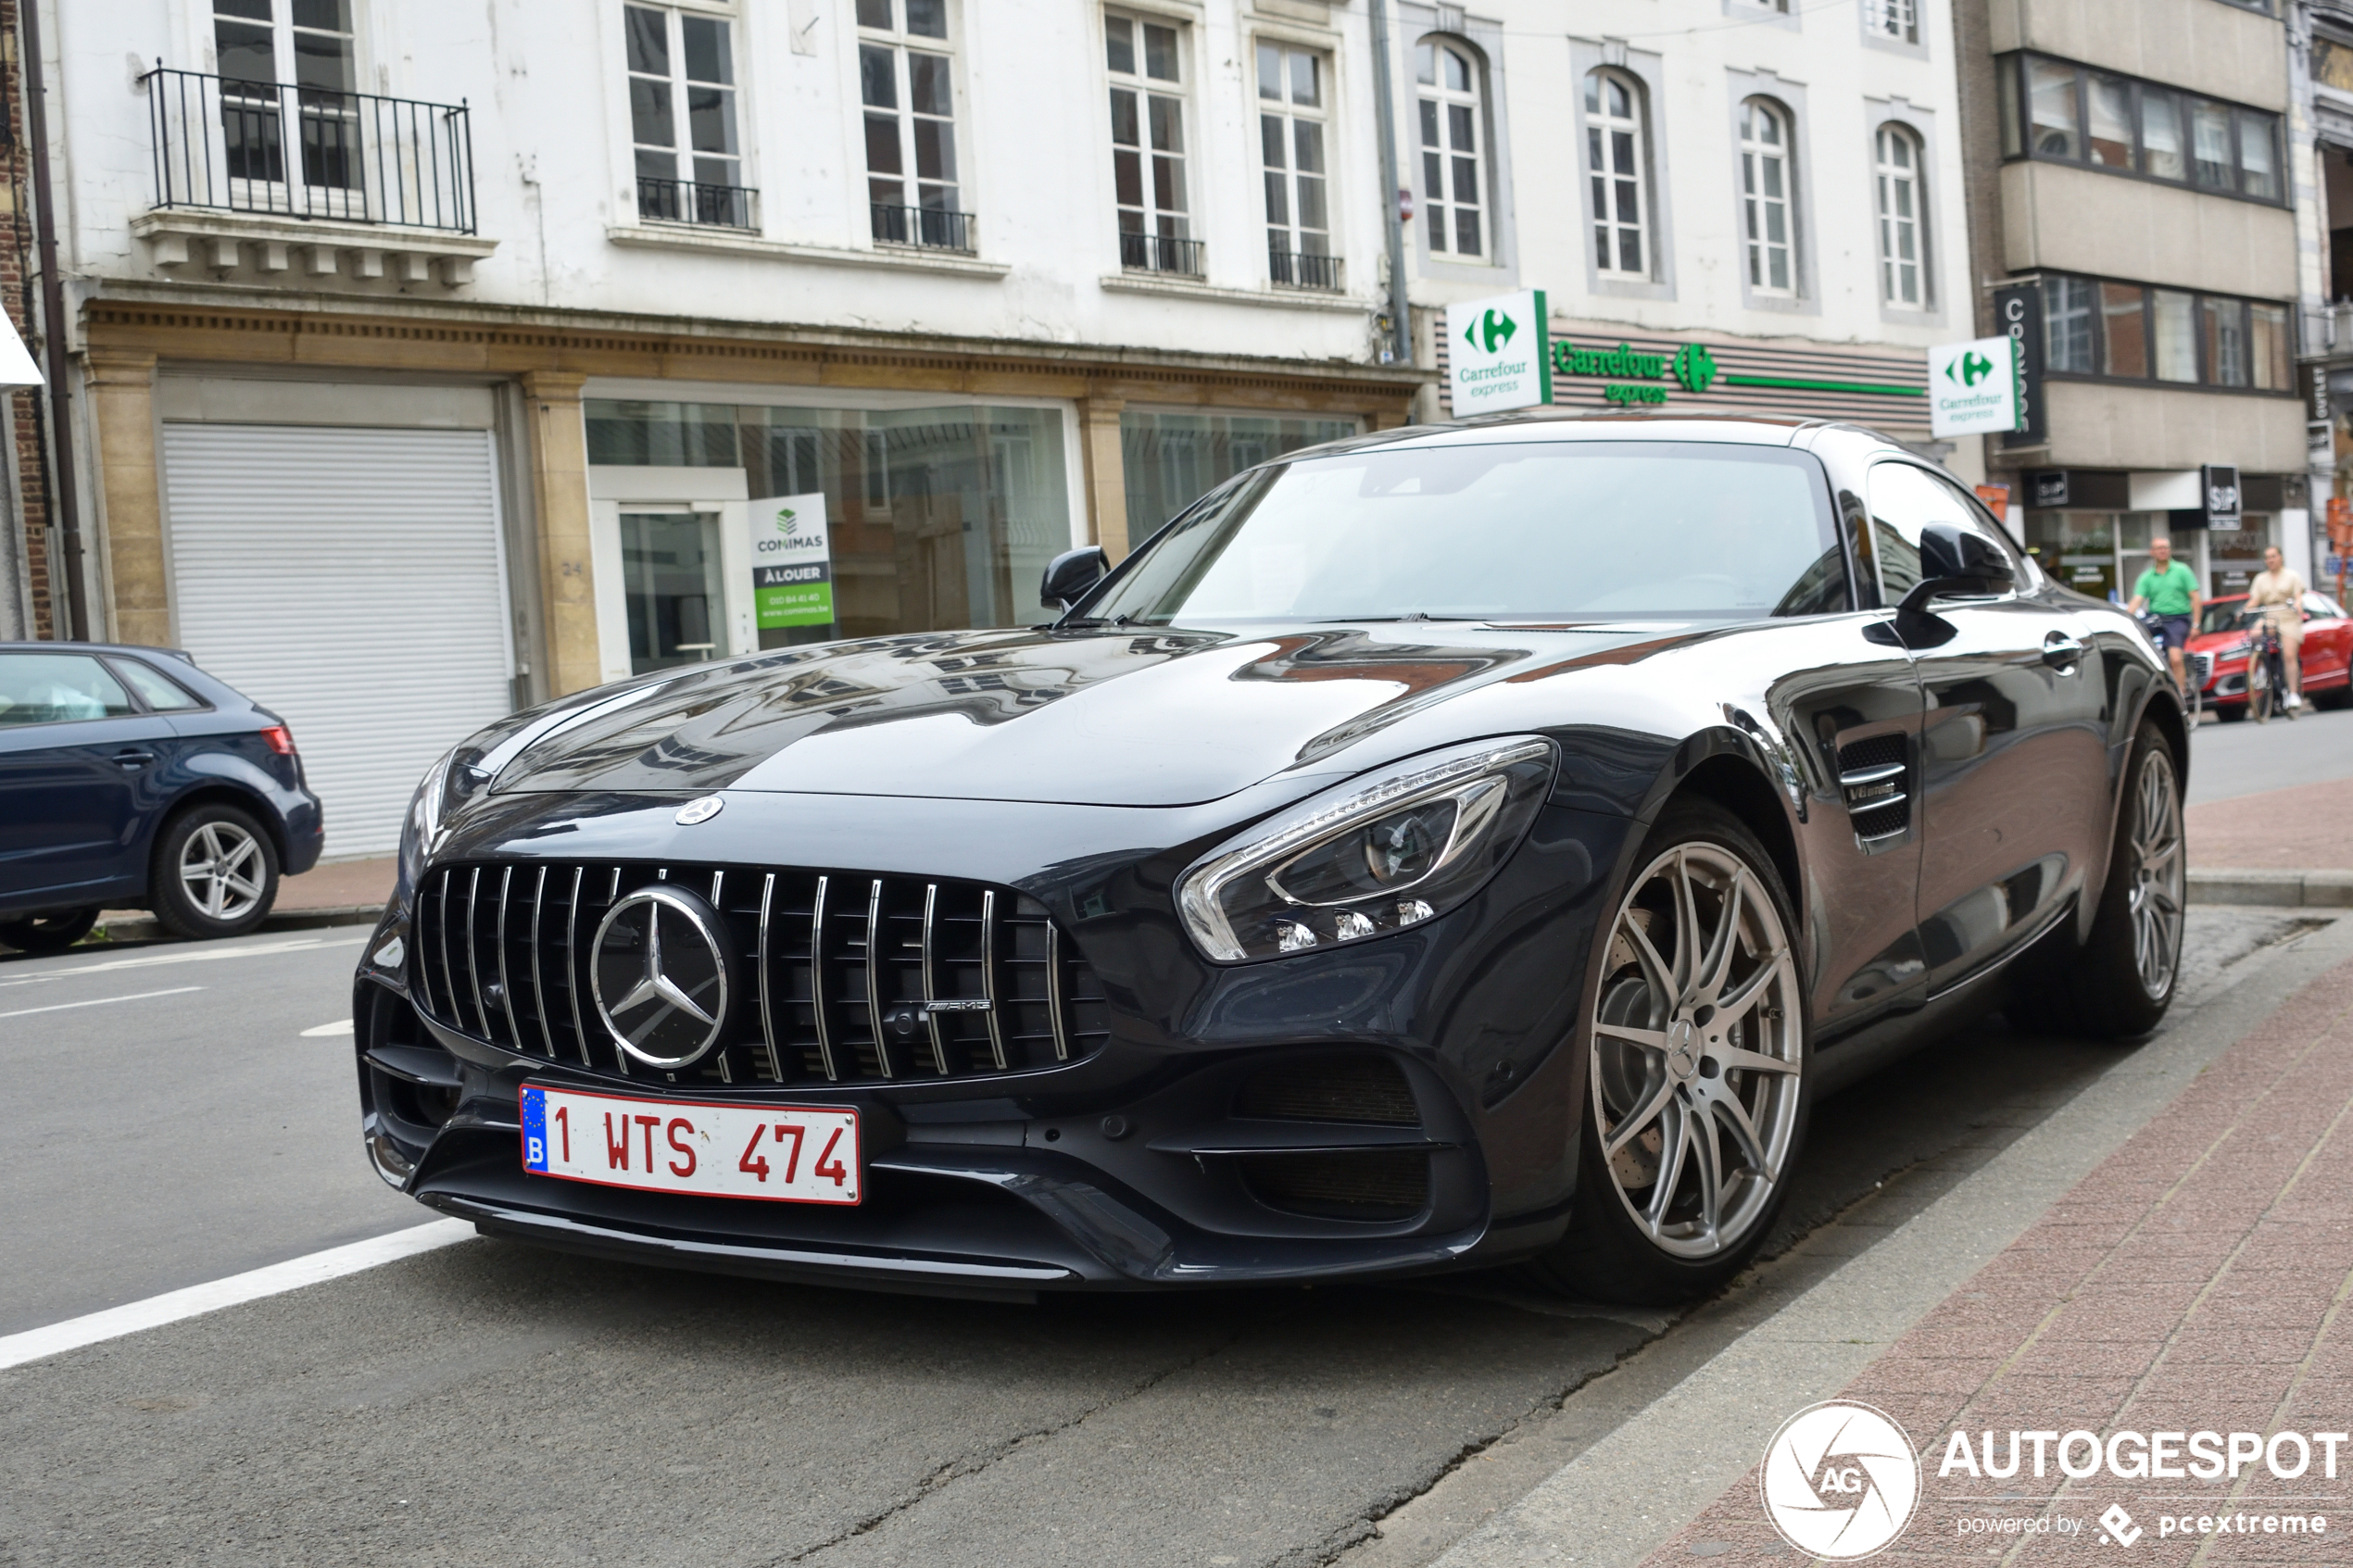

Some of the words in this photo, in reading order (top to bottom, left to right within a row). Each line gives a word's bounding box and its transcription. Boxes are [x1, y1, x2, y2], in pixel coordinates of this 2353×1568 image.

[1554, 340, 1667, 378] Carrefour
[1460, 359, 1528, 383] Carrefour
[1470, 380, 1519, 398] express
[1604, 383, 1667, 408] express
[2312, 366, 2328, 419] OUTLET
[1939, 394, 2002, 410] Carrefour
[1949, 409, 1994, 422] express
[758, 535, 823, 552] COMIMAS
[765, 568, 775, 583] À
[776, 567, 821, 582] LOUER
[947, 1001, 991, 1010] AMG
[528, 1136, 544, 1163] B
[555, 1106, 570, 1162] 1
[605, 1111, 697, 1178] WTS
[738, 1123, 847, 1186] 474
